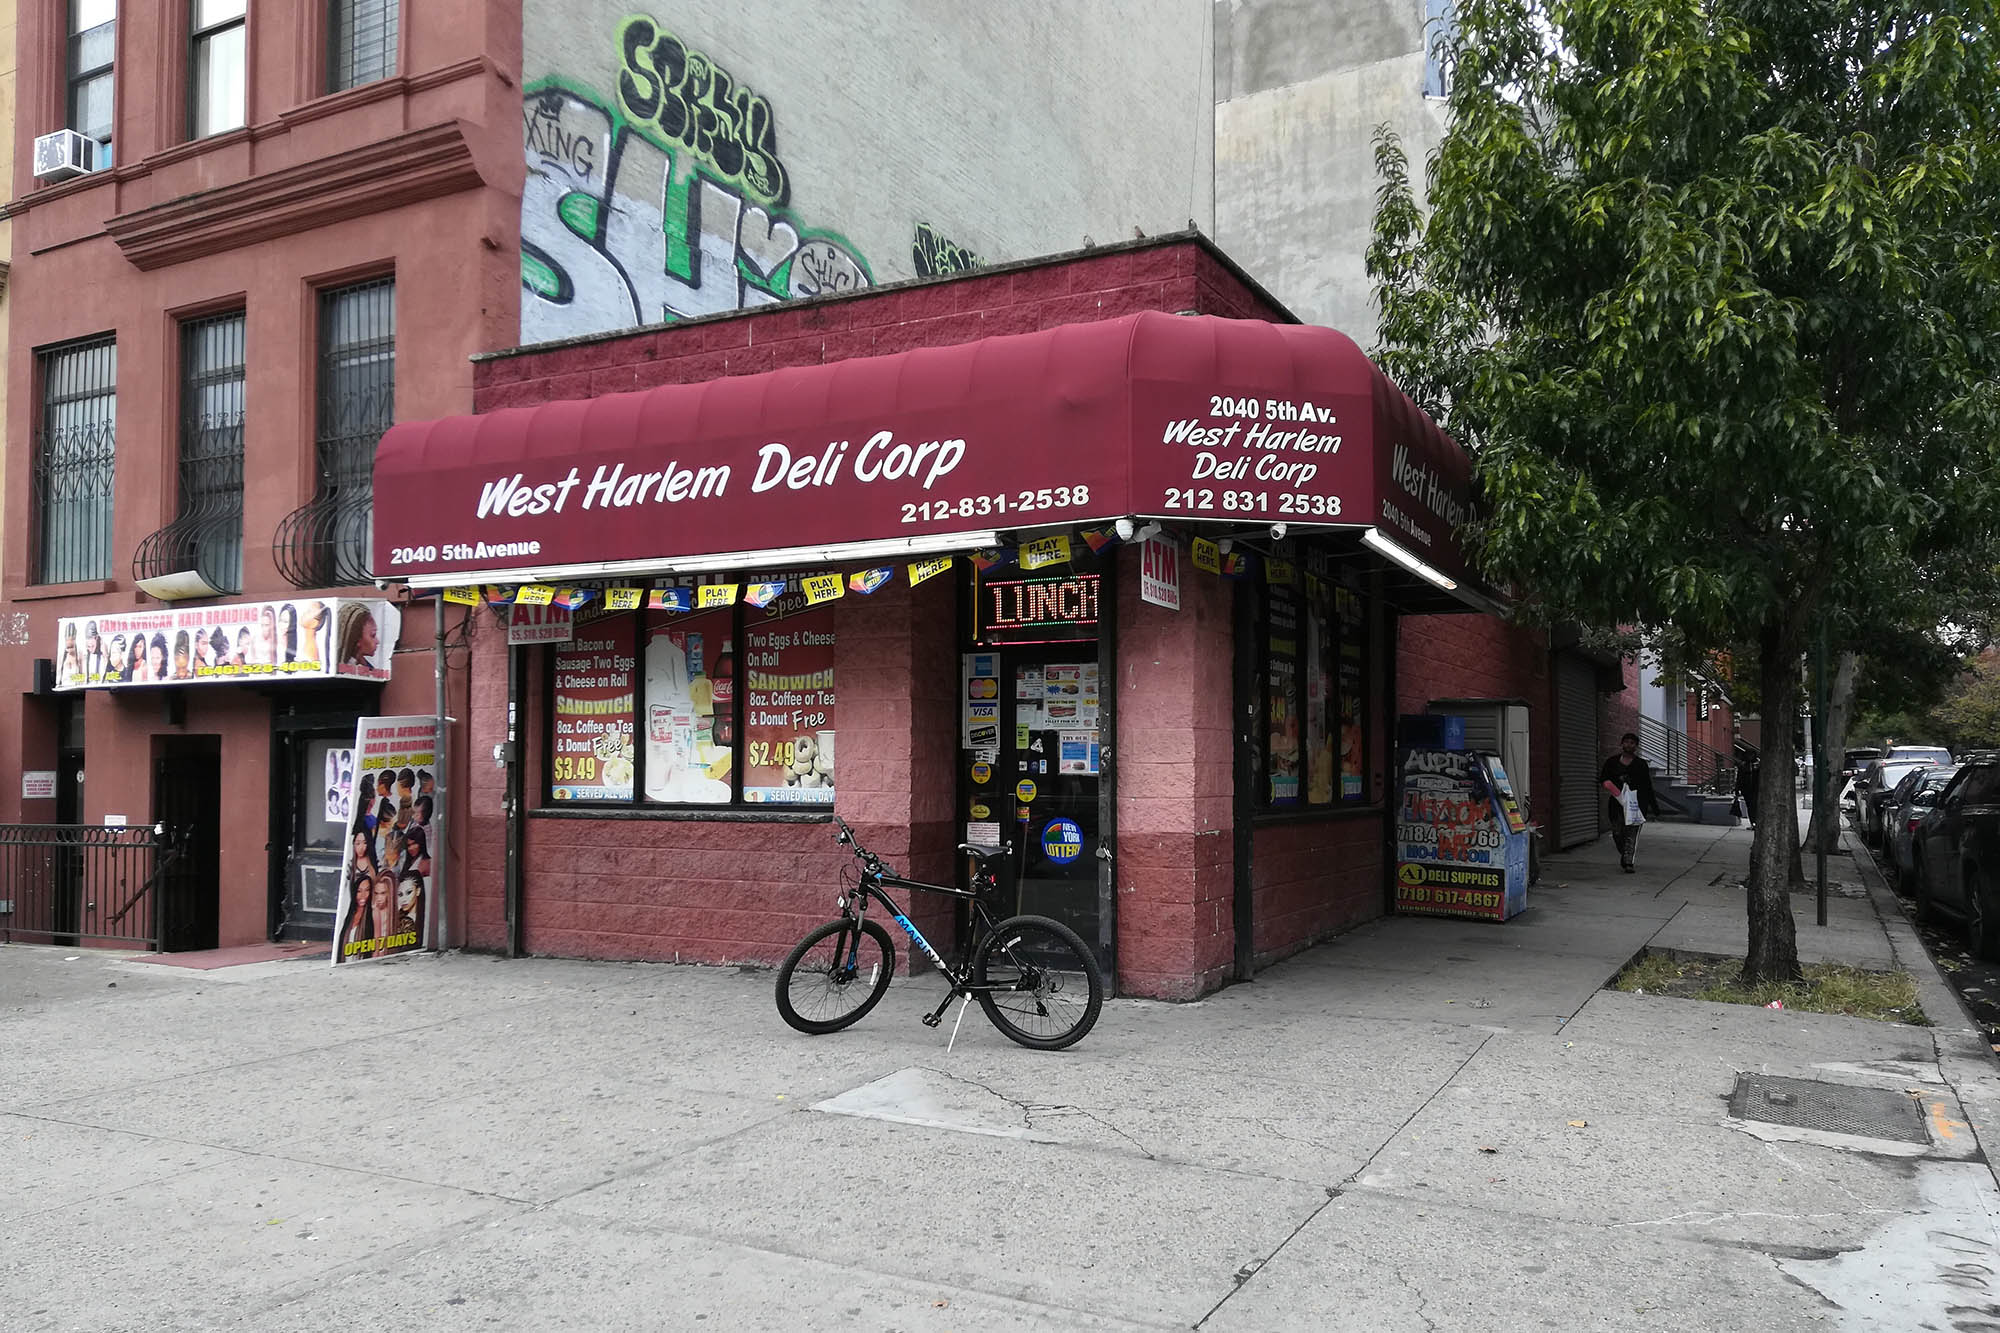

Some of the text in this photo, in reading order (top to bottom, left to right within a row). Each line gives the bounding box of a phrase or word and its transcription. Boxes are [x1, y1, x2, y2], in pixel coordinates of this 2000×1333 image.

[1210, 396, 1259, 419] 2040
[1162, 418, 1342, 454] West Harlem
[476, 430, 966, 519] West Harlem Deli Corp
[1192, 452, 1317, 488] Deli Corp
[1392, 444, 1426, 502] West
[1427, 470, 1464, 530] Harlem
[900, 484, 1090, 523] 212-831-2538
[1164, 488, 1342, 516] 212 831 2538
[1383, 498, 1399, 526] 2040
[391, 546, 436, 565] 2040
[475, 539, 541, 560] Avenue
[1028, 539, 1058, 553] PLAY
[1198, 543, 1214, 556] PLAY
[1029, 549, 1065, 564] HERE.
[1143, 538, 1177, 586] ATM
[706, 588, 729, 597] PLAY
[810, 578, 834, 591] PLAY
[612, 590, 634, 600] PLAY
[993, 580, 1100, 623] LUNCH
[178, 611, 201, 627] HAIR
[206, 607, 258, 625] BRAIDING
[577, 638, 604, 651] Bacon
[605, 640, 615, 651] or
[748, 631, 835, 650] Two Eggs & Cheese
[556, 655, 635, 673] Sausage Two Eggs
[748, 651, 779, 666] On Roll
[556, 673, 628, 689] & Cheese on Roll
[748, 668, 834, 691] SANDWICH
[556, 692, 634, 715] SANDWICH
[750, 691, 835, 706] 8oz. Coffee or Tea
[750, 710, 826, 731] & Donut Free
[973, 708, 993, 716] VISA
[396, 725, 436, 738] AFRICAN
[557, 720, 574, 734] 8oz.
[576, 719, 604, 734] Coffee
[617, 720, 633, 733] Tea
[364, 739, 435, 754] HAIR BRAIDING
[557, 737, 622, 757] & Donut Free
[749, 740, 795, 768] $2.49
[554, 756, 595, 781] $3.49
[576, 788, 603, 799] SERVED
[770, 791, 833, 802] SERVED ALL DAY
[1063, 823, 1076, 832] NEW
[1063, 831, 1080, 842] YORK
[1045, 843, 1081, 857] LOTTERY
[1428, 869, 1449, 883] DELI
[1451, 871, 1499, 887] SUPPLIES
[1434, 889, 1500, 908] 617-4867
[344, 931, 417, 956] OPEN 7 DAYS
[898, 918, 934, 960] MARIN
